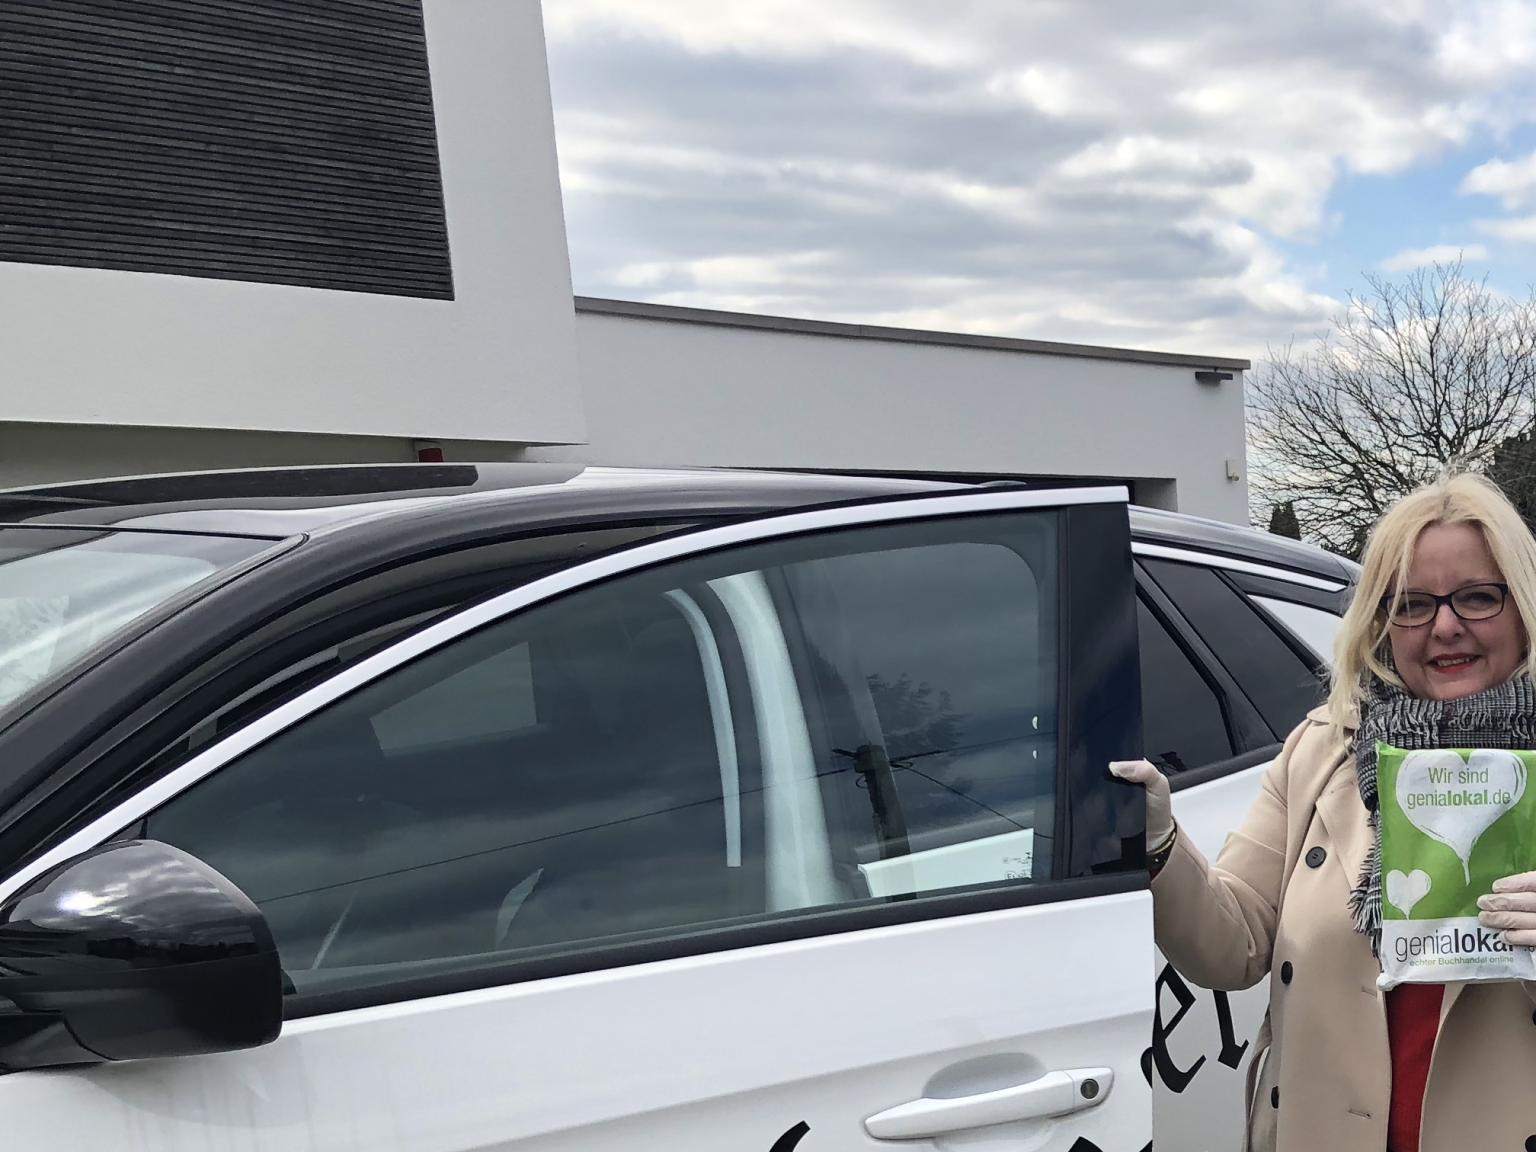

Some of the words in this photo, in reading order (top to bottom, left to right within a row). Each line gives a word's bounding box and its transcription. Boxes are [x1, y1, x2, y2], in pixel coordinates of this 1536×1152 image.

[1428, 767, 1453, 784] Wir
[1458, 767, 1489, 784] sind
[1407, 788, 1511, 810] genialokal.de
[1409, 958, 1436, 967] echter
[1438, 956, 1487, 966] Buchhandel
[1489, 955, 1514, 964] online
